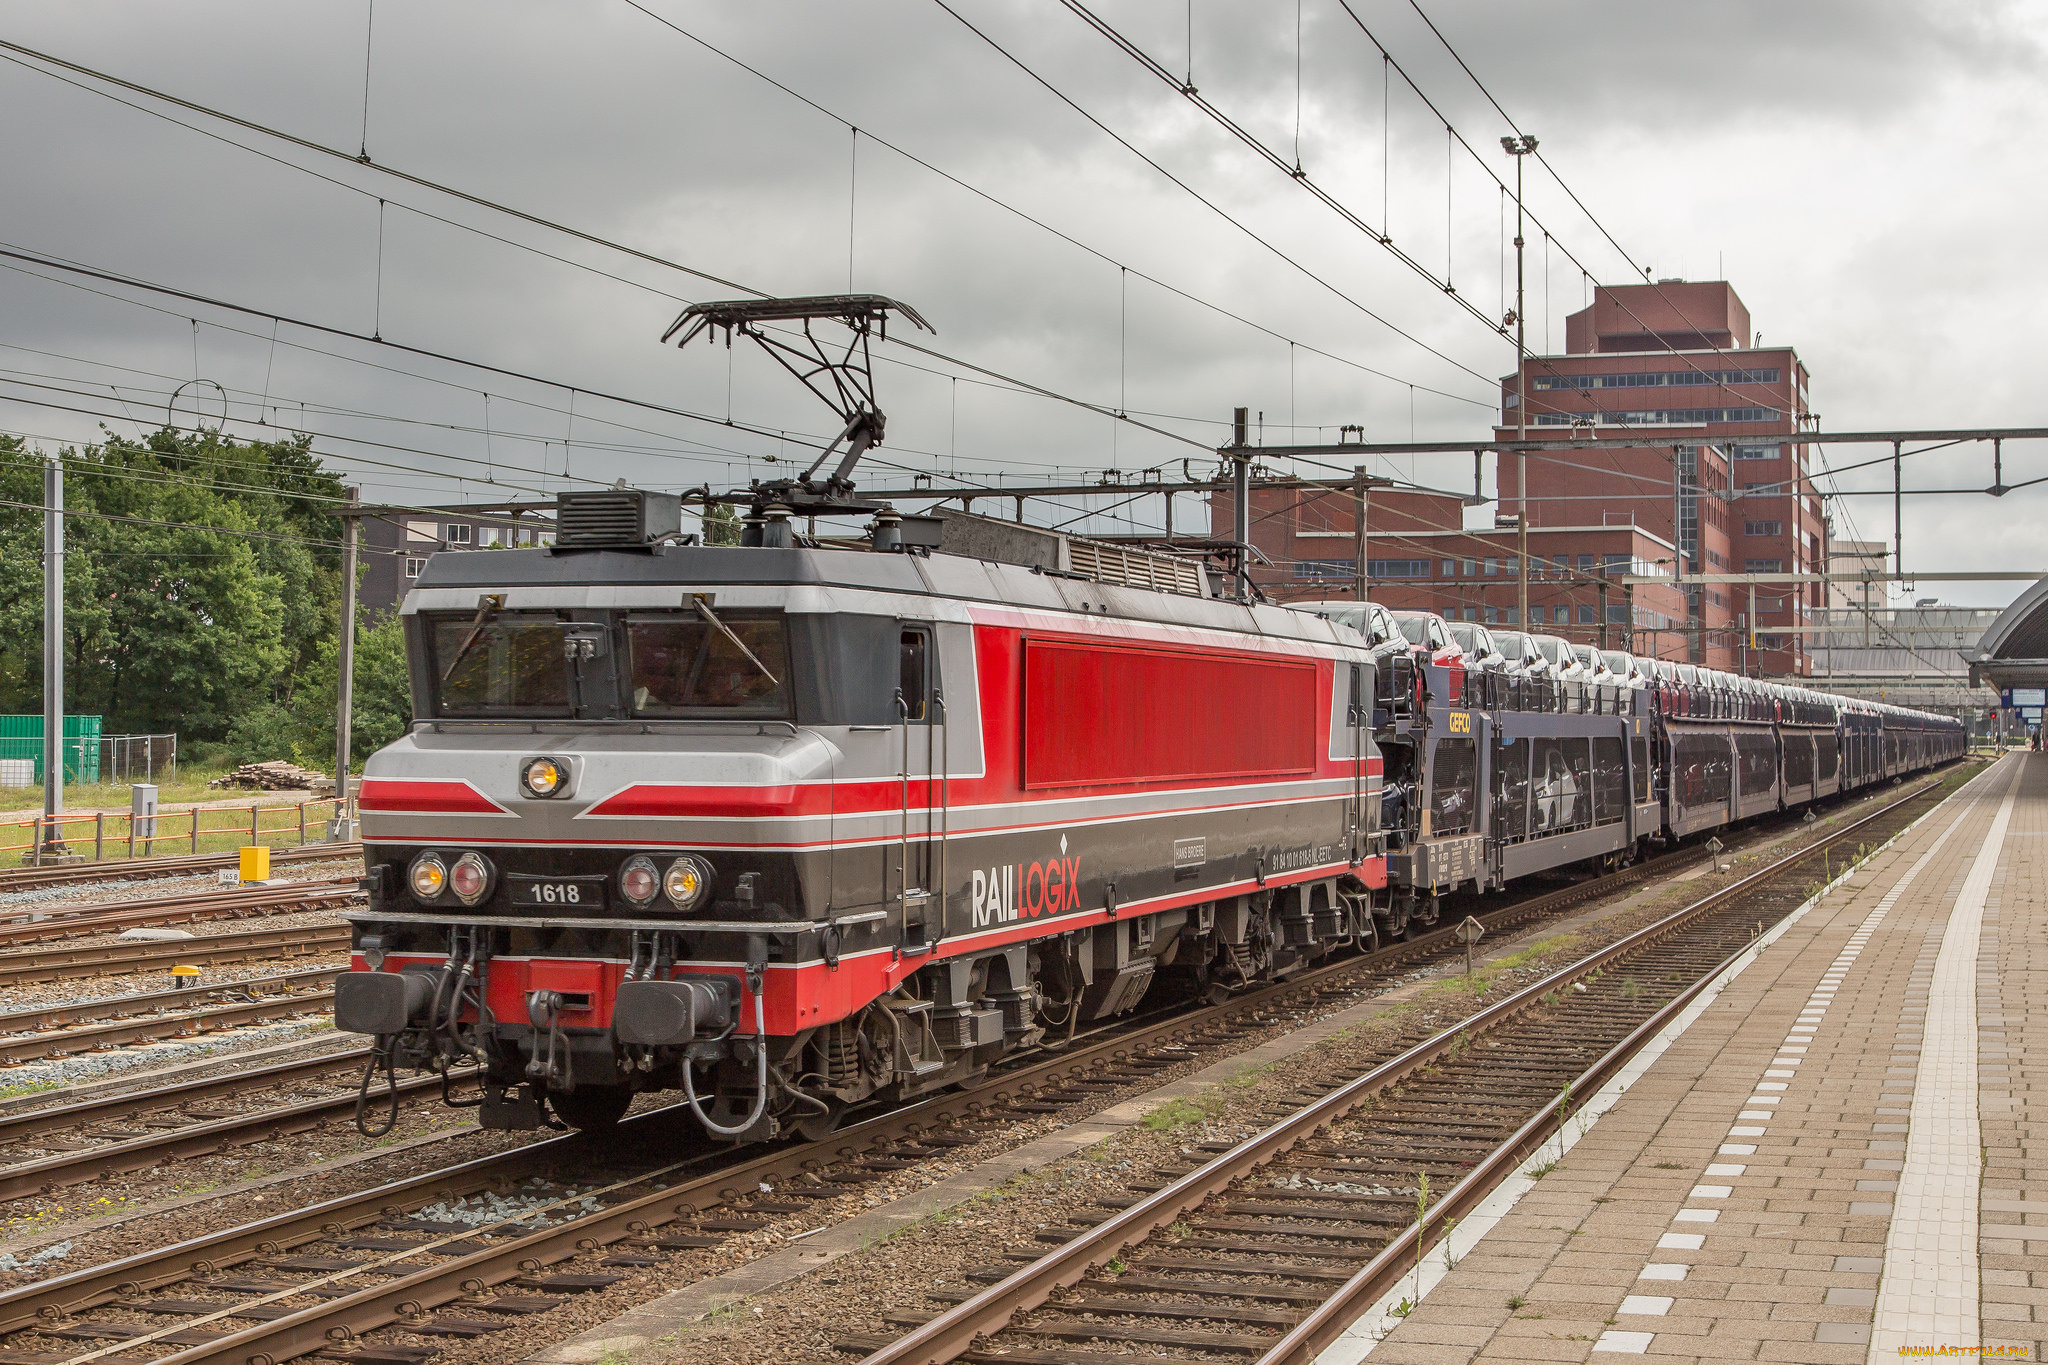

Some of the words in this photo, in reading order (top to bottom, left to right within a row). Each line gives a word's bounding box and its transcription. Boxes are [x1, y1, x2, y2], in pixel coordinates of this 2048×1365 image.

[1450, 712, 1470, 734] GEFCO
[1176, 846, 1187, 860] HANS
[1272, 854, 1278, 870] 91
[531, 883, 580, 903] 1618
[972, 855, 1081, 928] RAILLOGIX
